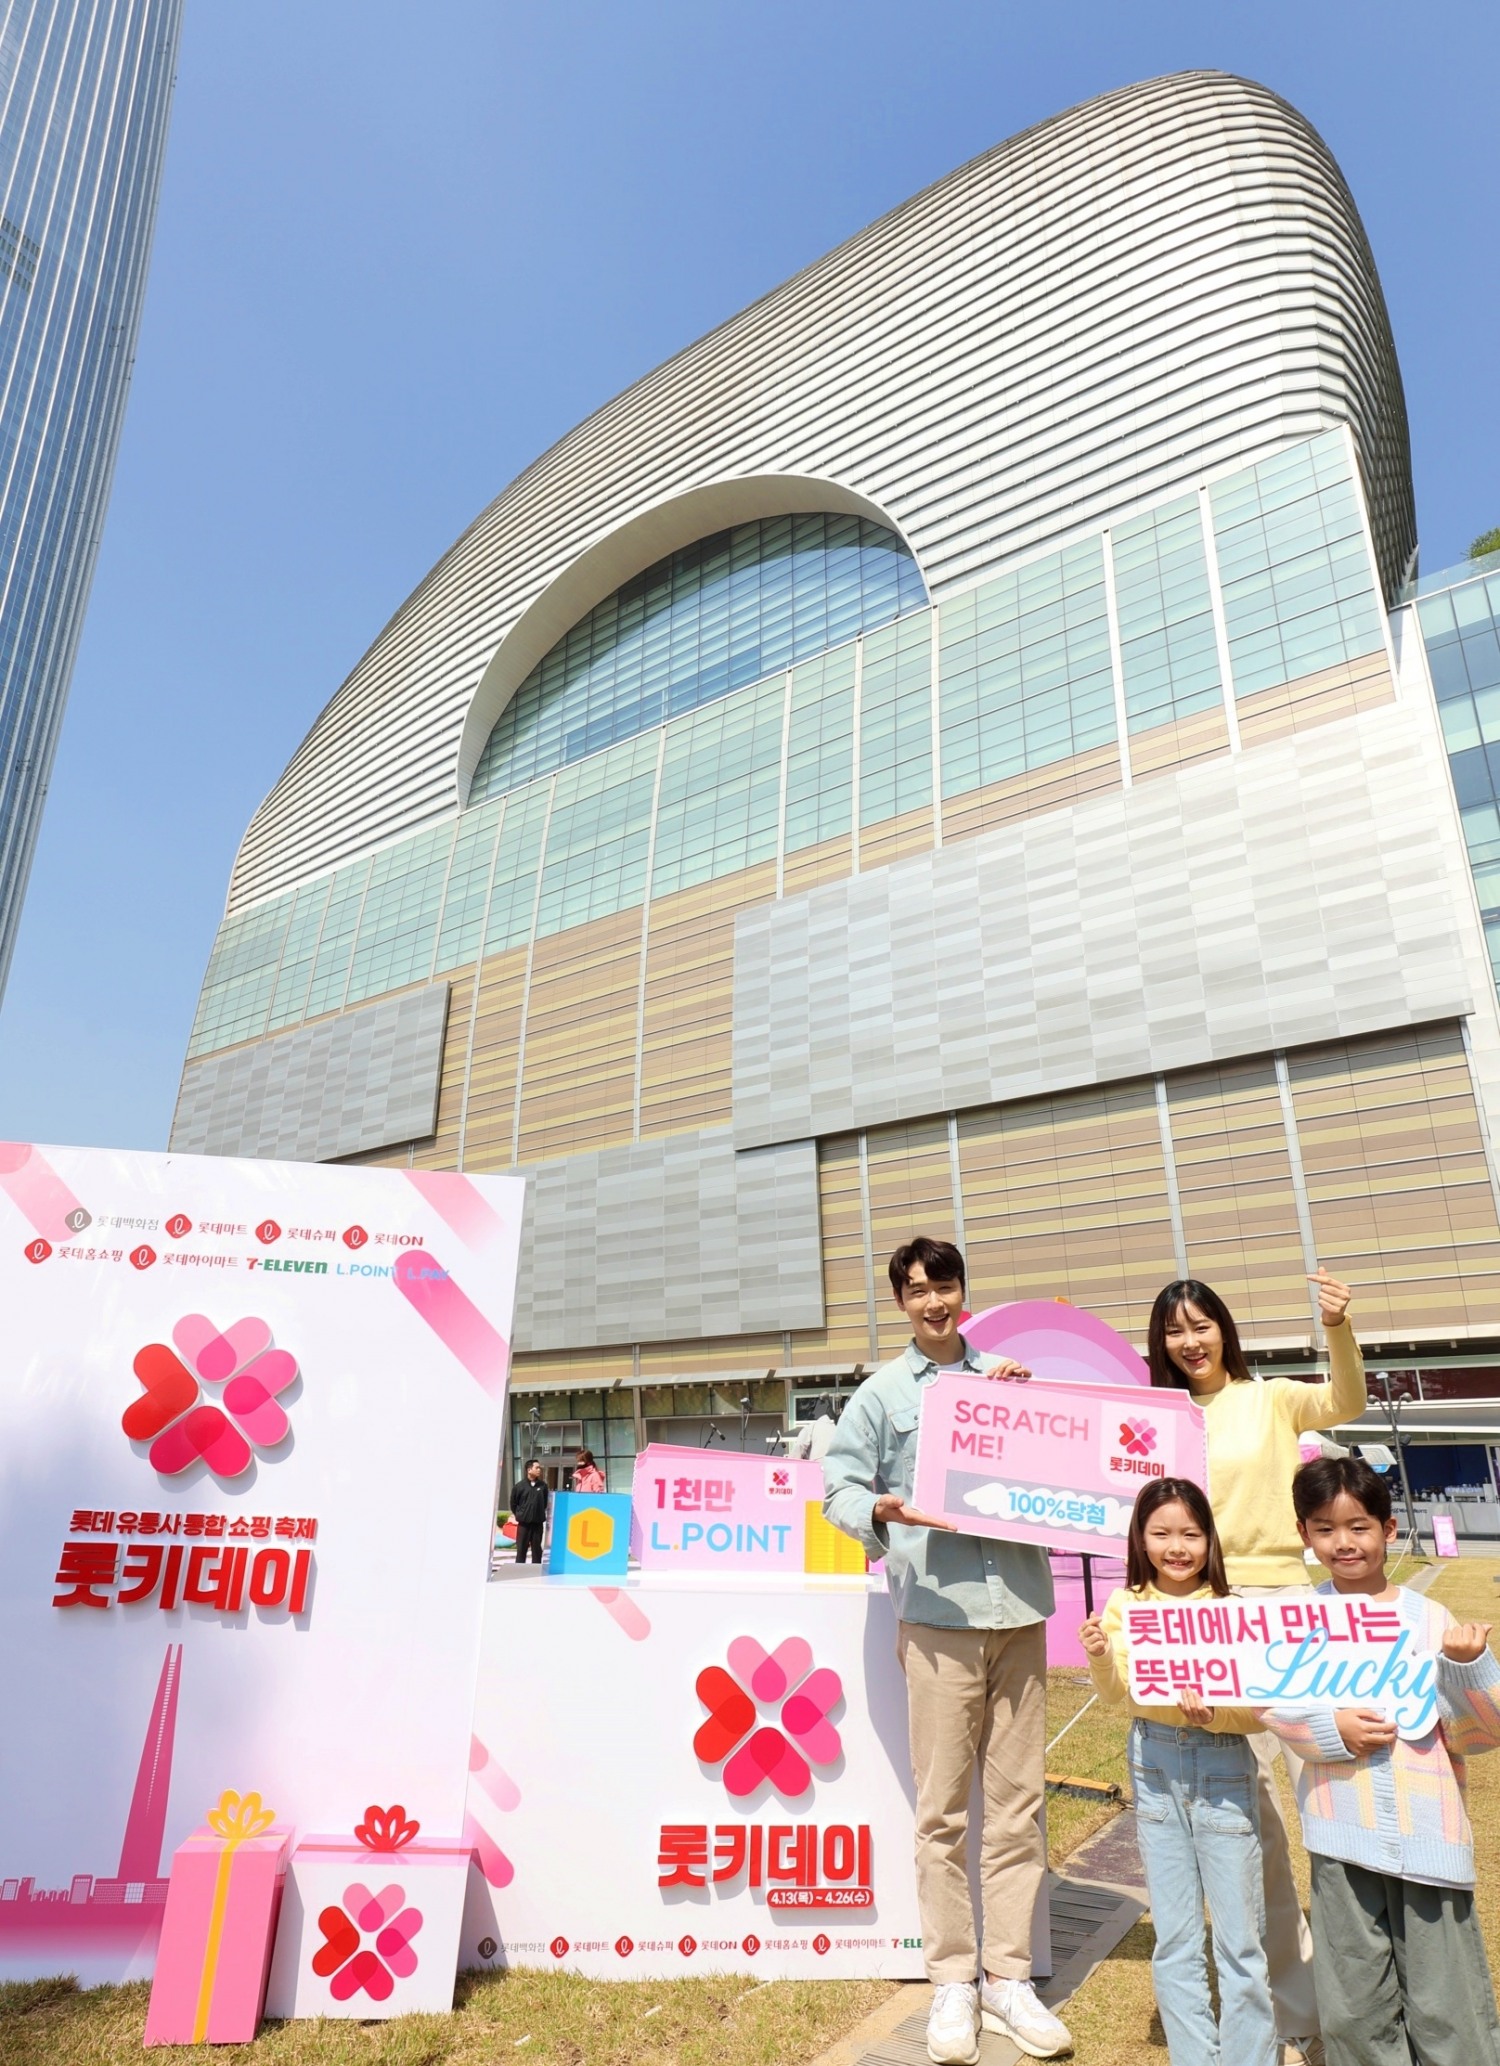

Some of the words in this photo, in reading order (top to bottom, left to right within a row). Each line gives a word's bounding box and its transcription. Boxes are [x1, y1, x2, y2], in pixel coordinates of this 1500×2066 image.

[97, 1215, 160, 1231] 롯데백화점
[198, 1221, 248, 1236] 롯데마트
[287, 1227, 337, 1242] 롯데슈퍼
[374, 1233, 424, 1247] 롯데ON
[58, 1246, 124, 1263] 롯데홈쇼핑
[162, 1252, 239, 1268] 롯데하이마트
[336, 1263, 398, 1279] L.POINT
[407, 1269, 450, 1282] L.PAY
[954, 1399, 1090, 1442] SCRATCH
[951, 1430, 1004, 1460] ME!
[1109, 1456, 1165, 1479] 롯키데이
[654, 1478, 735, 1512] 1천만
[1008, 1491, 1106, 1526] 100%당첨
[70, 1510, 115, 1533] 롯데
[116, 1511, 182, 1536] 유통사
[183, 1513, 227, 1537] 통합
[228, 1516, 271, 1538] 쇼핑
[274, 1516, 319, 1540] 축제
[651, 1522, 792, 1553] L.POINT
[52, 1541, 314, 1613] 롯키데이
[1128, 1605, 1271, 1646] 롯데에서
[1280, 1601, 1401, 1644] 만나는
[1135, 1658, 1242, 1699] 뜻밖의
[1245, 1626, 1437, 1731] Lucky
[657, 1824, 871, 1888] 롯키데이
[770, 1891, 813, 1905] 4.13(목)
[825, 1891, 870, 1905] 4.26(수)
[573, 1940, 610, 1952] 롯데마트
[637, 1940, 674, 1952] 롯데슈퍼
[701, 1940, 737, 1950] 롯데ON
[764, 1939, 809, 1951] 롯데홈쇼핑
[834, 1938, 887, 1950] 롯데하이마트
